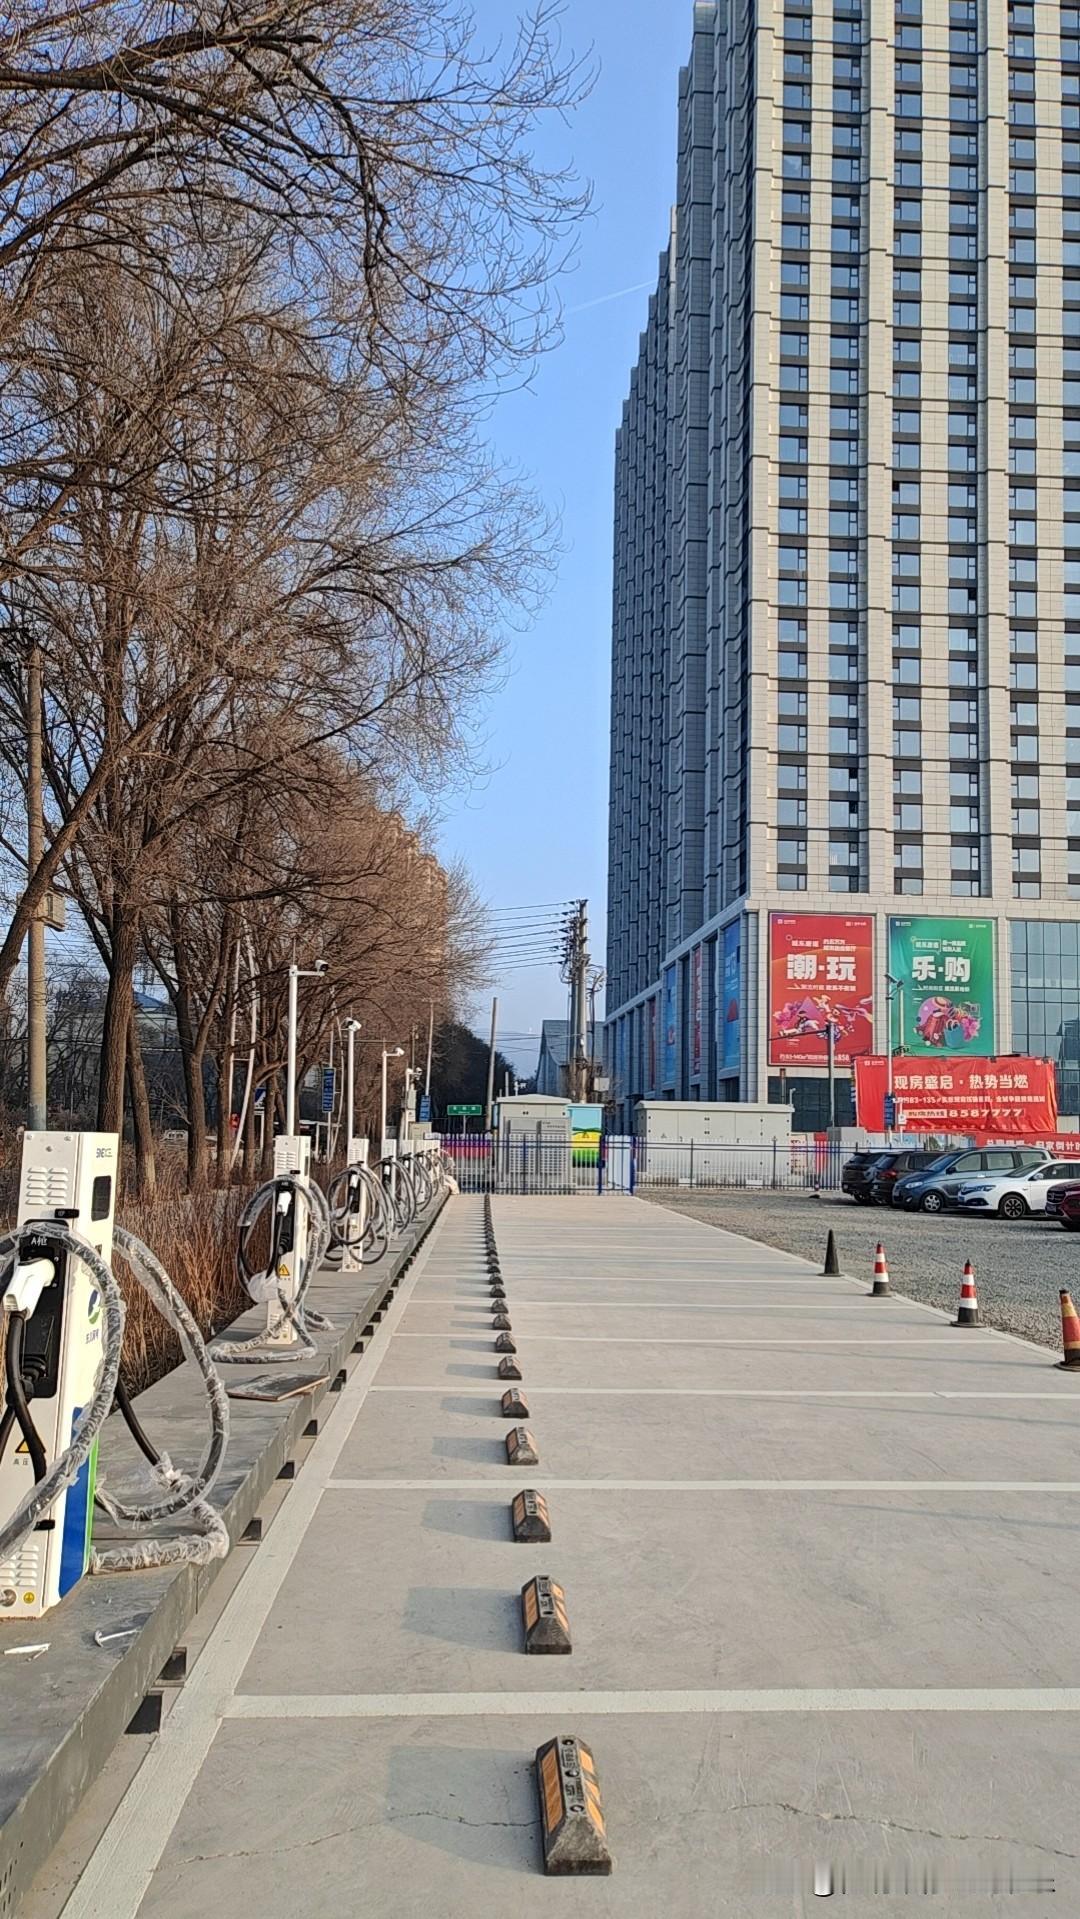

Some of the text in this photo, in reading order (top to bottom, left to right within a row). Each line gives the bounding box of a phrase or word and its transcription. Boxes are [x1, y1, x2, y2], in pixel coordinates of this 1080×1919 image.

[787, 954, 856, 982] 潮·玩
[912, 956, 970, 983] 乐·购
[949, 1109, 1022, 1118] 8587777
